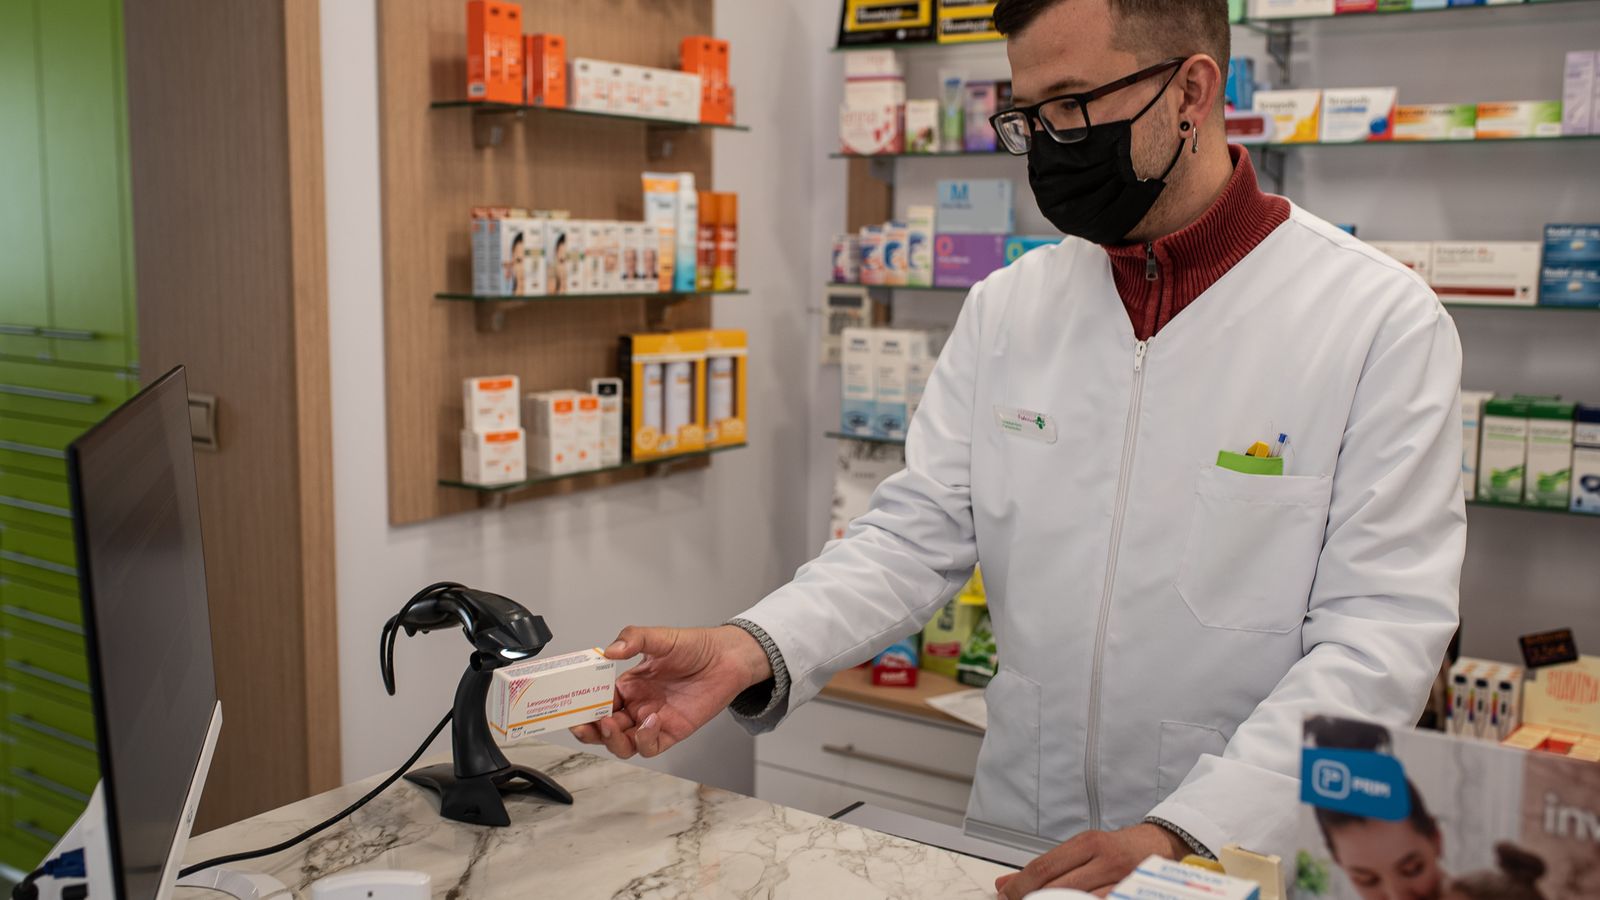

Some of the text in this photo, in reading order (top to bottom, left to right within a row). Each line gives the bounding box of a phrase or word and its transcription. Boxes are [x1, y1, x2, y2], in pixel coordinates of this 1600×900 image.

[526, 691, 571, 709] Levonorgestrel
[571, 687, 591, 698] STADA
[601, 684, 610, 692] mg
